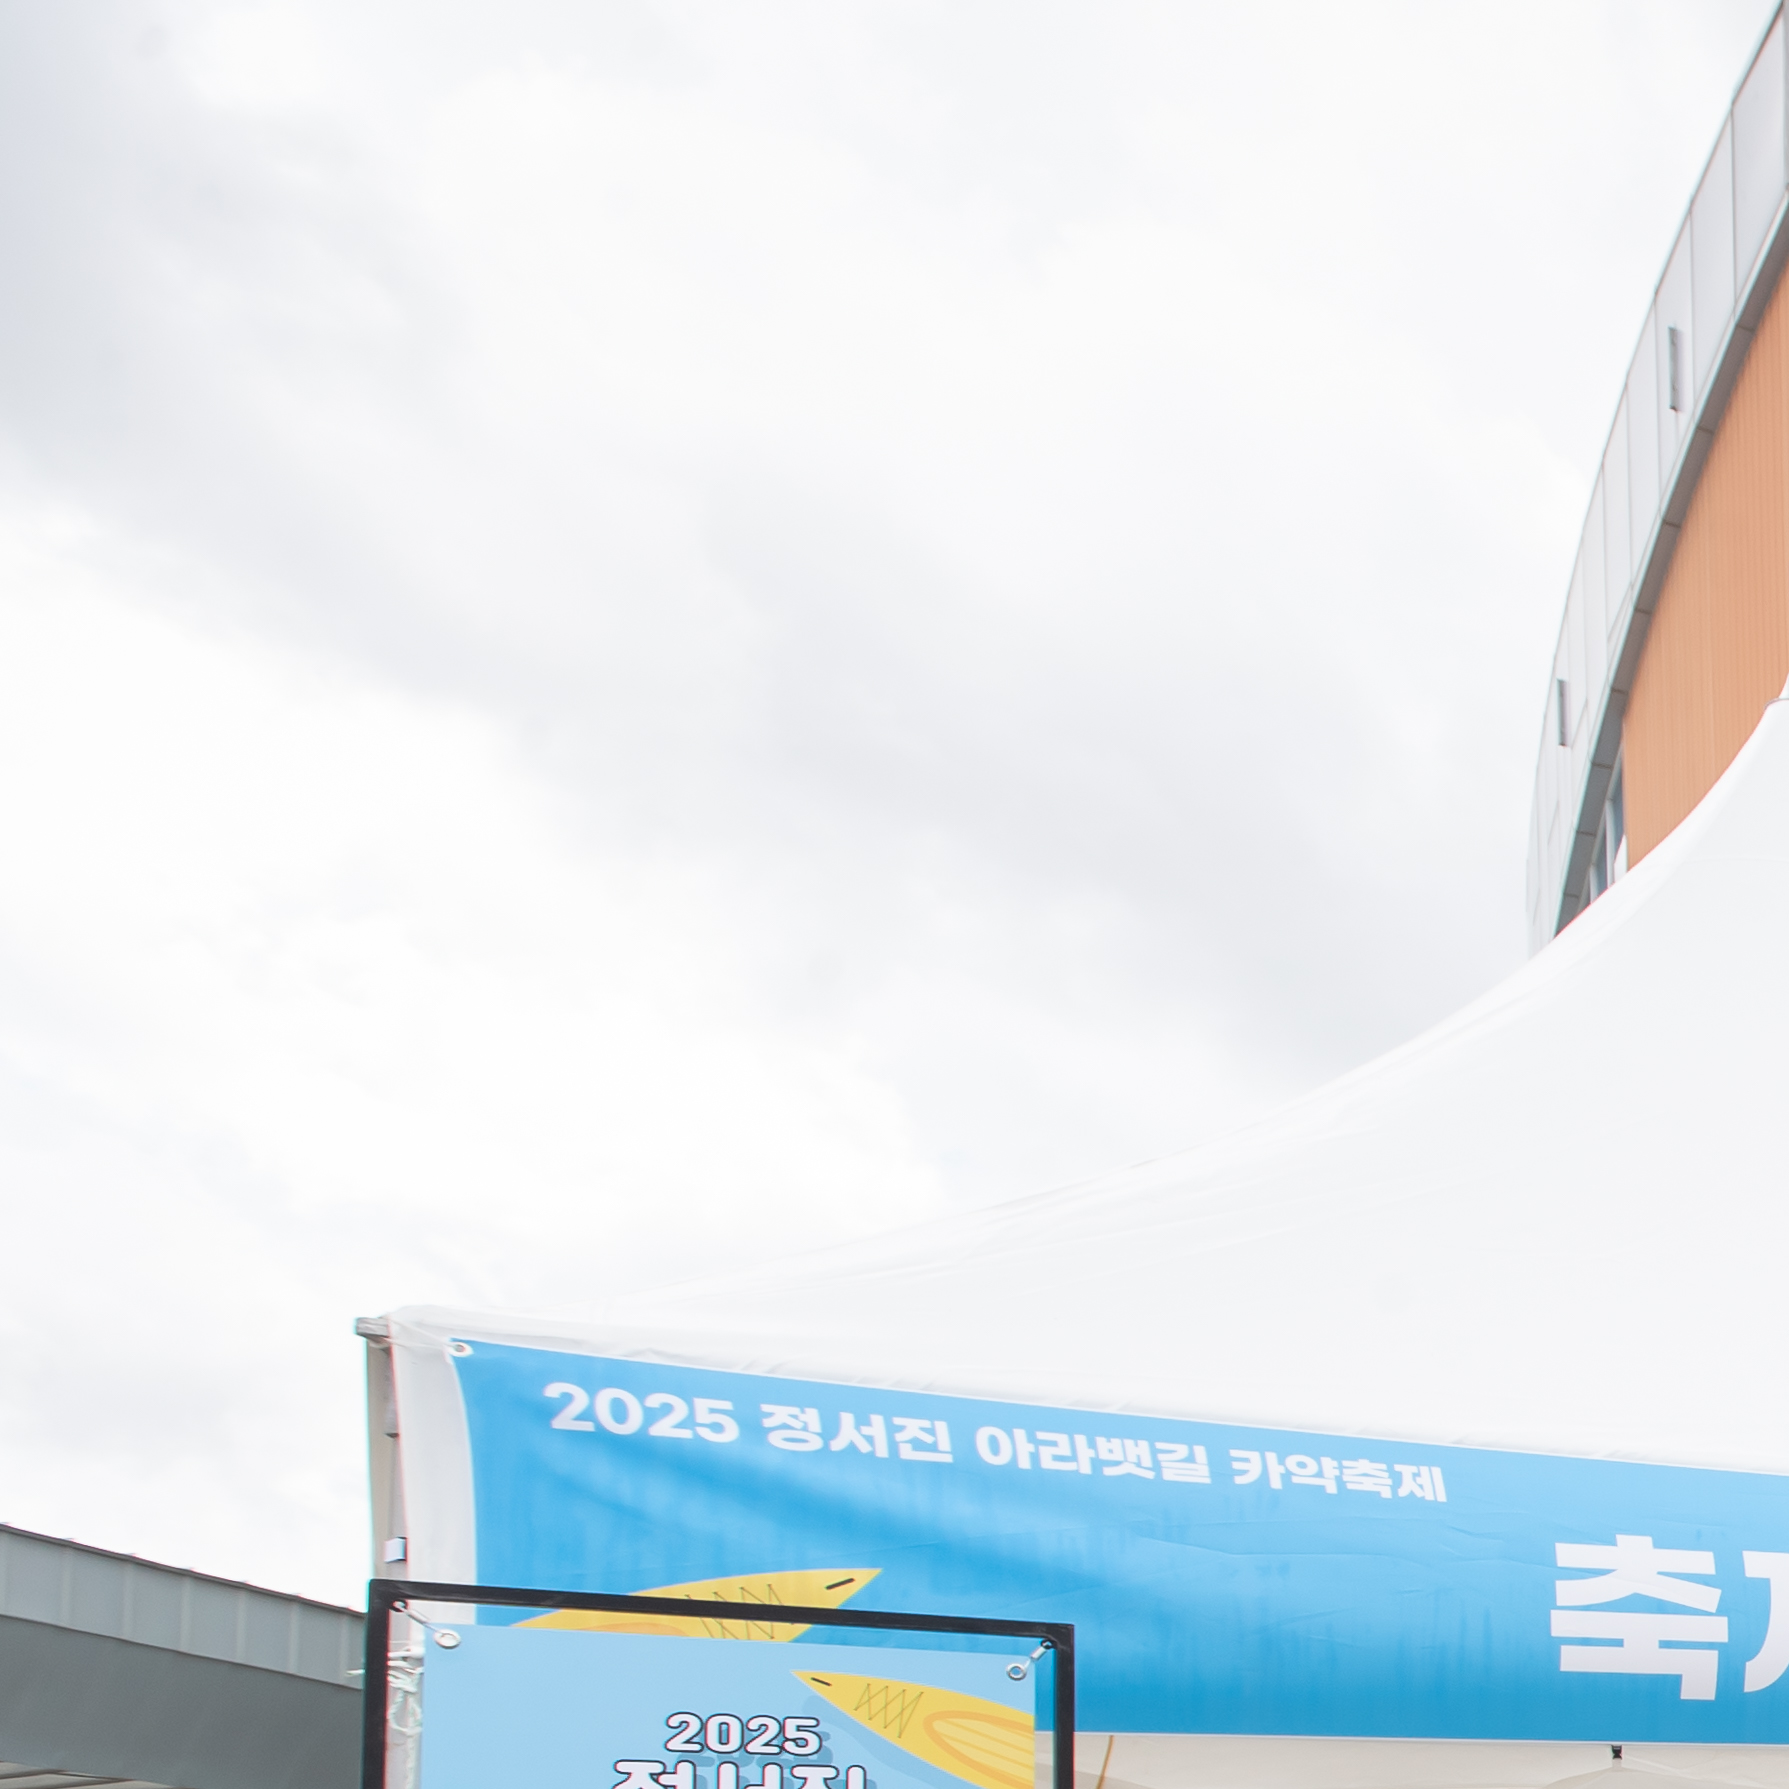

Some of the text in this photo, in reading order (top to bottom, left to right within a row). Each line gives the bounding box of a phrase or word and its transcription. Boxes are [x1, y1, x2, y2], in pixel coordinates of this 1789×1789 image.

[541, 1381, 1448, 1504] 2025 정서진 아라뱃길 카약축제
[665, 1711, 822, 1756] 2025
